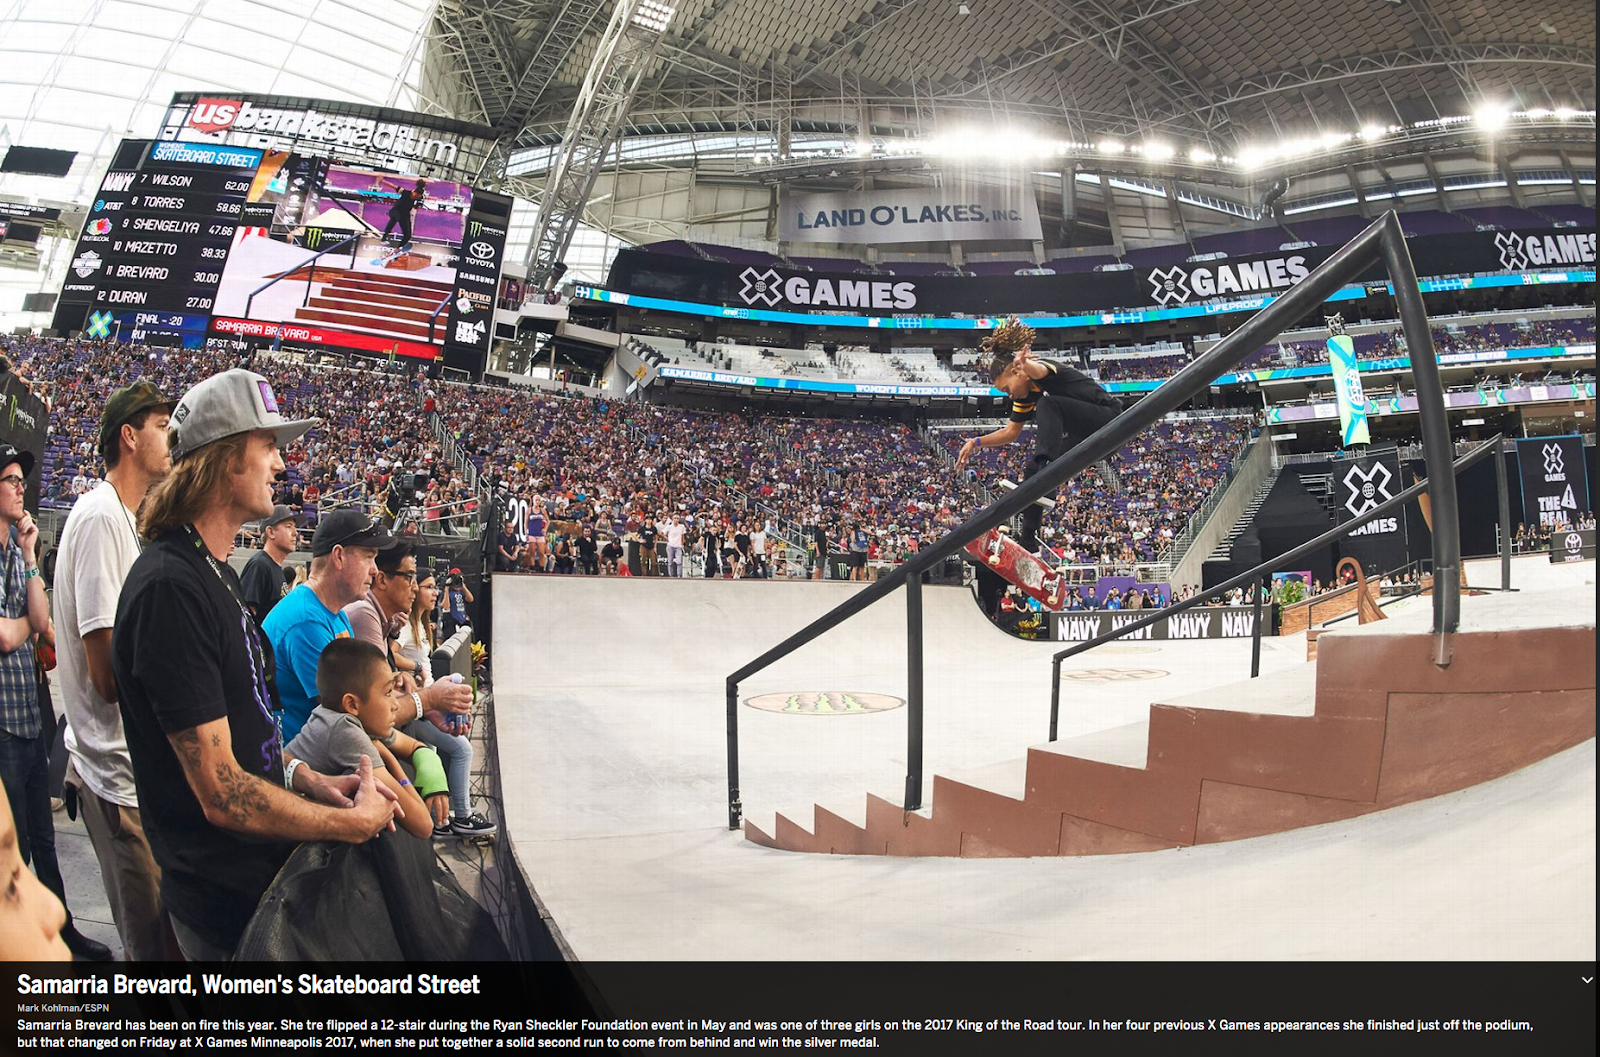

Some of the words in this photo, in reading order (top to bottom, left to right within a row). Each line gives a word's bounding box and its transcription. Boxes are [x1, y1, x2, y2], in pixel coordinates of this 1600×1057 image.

[153, 148, 216, 164] SKATEBOARD
[216, 152, 257, 168] STREET
[140, 174, 148, 183] 7
[152, 174, 193, 187] WILSON
[224, 181, 249, 192] 62.00
[103, 202, 124, 210] AT&T
[131, 196, 138, 206] 8
[143, 196, 185, 209] TORRES
[216, 203, 241, 214] 58.66
[122, 218, 129, 228] 9
[133, 218, 200, 234] SHENGELIYA
[208, 225, 234, 236] 47.66
[797, 208, 865, 229] LAND
[992, 209, 1022, 221] INC.
[113, 241, 122, 251] 10
[125, 241, 177, 256] MAZETTO
[201, 248, 226, 259] 38.33
[465, 257, 495, 269] TOYOTA
[105, 265, 113, 275] 11
[116, 265, 169, 280] BREVARD
[193, 271, 219, 284] 30.00
[459, 272, 495, 285] SAMSUNG
[1190, 255, 1310, 297] GAMES
[97, 290, 106, 301] 12
[109, 290, 148, 304] DURAN
[186, 296, 212, 309] 27.00
[784, 276, 917, 310] GAMES
[1205, 299, 1264, 313] LIFEPROOF
[135, 313, 159, 325] FINAL
[215, 320, 262, 334] SAMARRIA
[662, 368, 712, 381] SAMARRIA
[714, 373, 757, 386] BREVARD
[855, 384, 897, 394] WOMEN'S
[898, 386, 957, 396] SKATEBOARD
[958, 387, 991, 396] STREET
[1544, 473, 1566, 482] GAMES
[1538, 496, 1561, 511] THE
[1539, 511, 1568, 526] REAL
[1057, 619, 1101, 640] NAVY
[1168, 616, 1211, 638] NAVY
[1222, 614, 1263, 637] NAV
